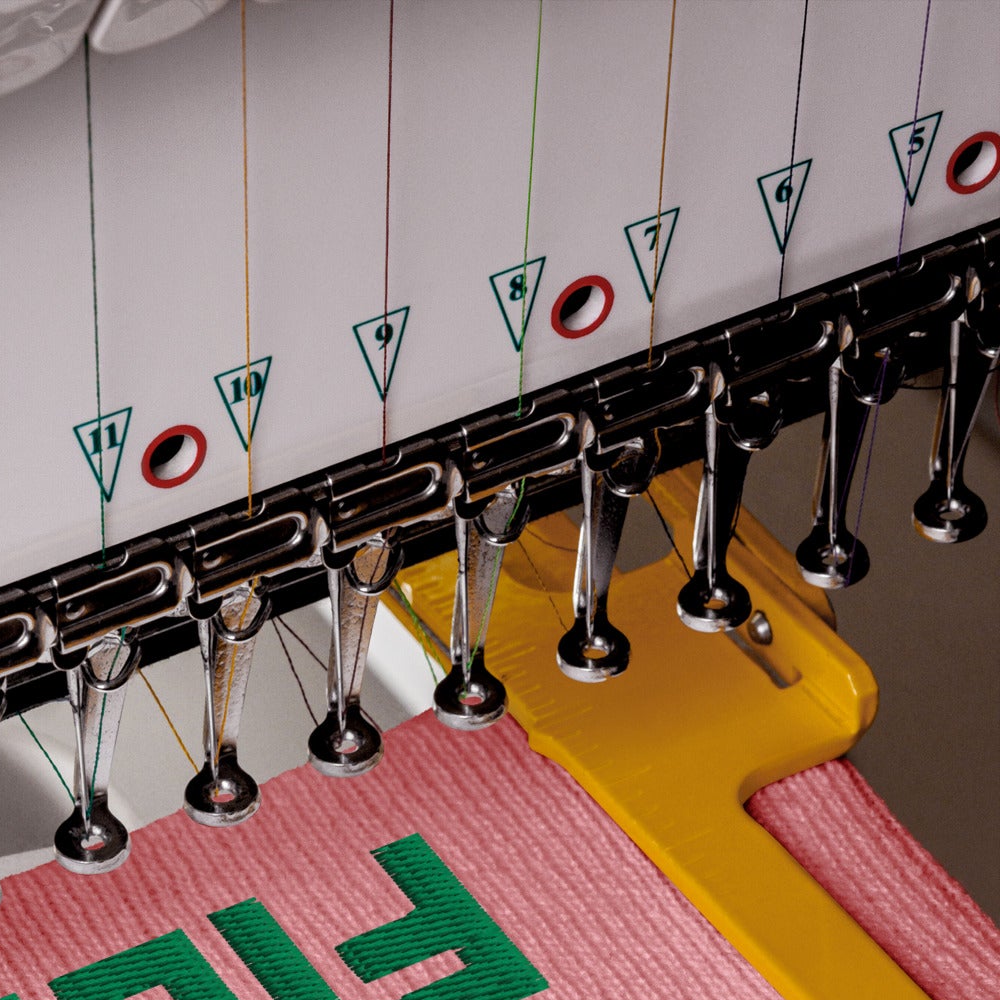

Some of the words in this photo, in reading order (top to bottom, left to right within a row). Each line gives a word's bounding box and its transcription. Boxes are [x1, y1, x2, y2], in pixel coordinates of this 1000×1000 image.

[908, 126, 926, 155] 5
[774, 175, 793, 203] 6
[644, 223, 662, 251] 7
[508, 274, 527, 302] 8
[374, 323, 394, 350] 9
[229, 371, 264, 405] 10
[87, 422, 122, 455] 11
